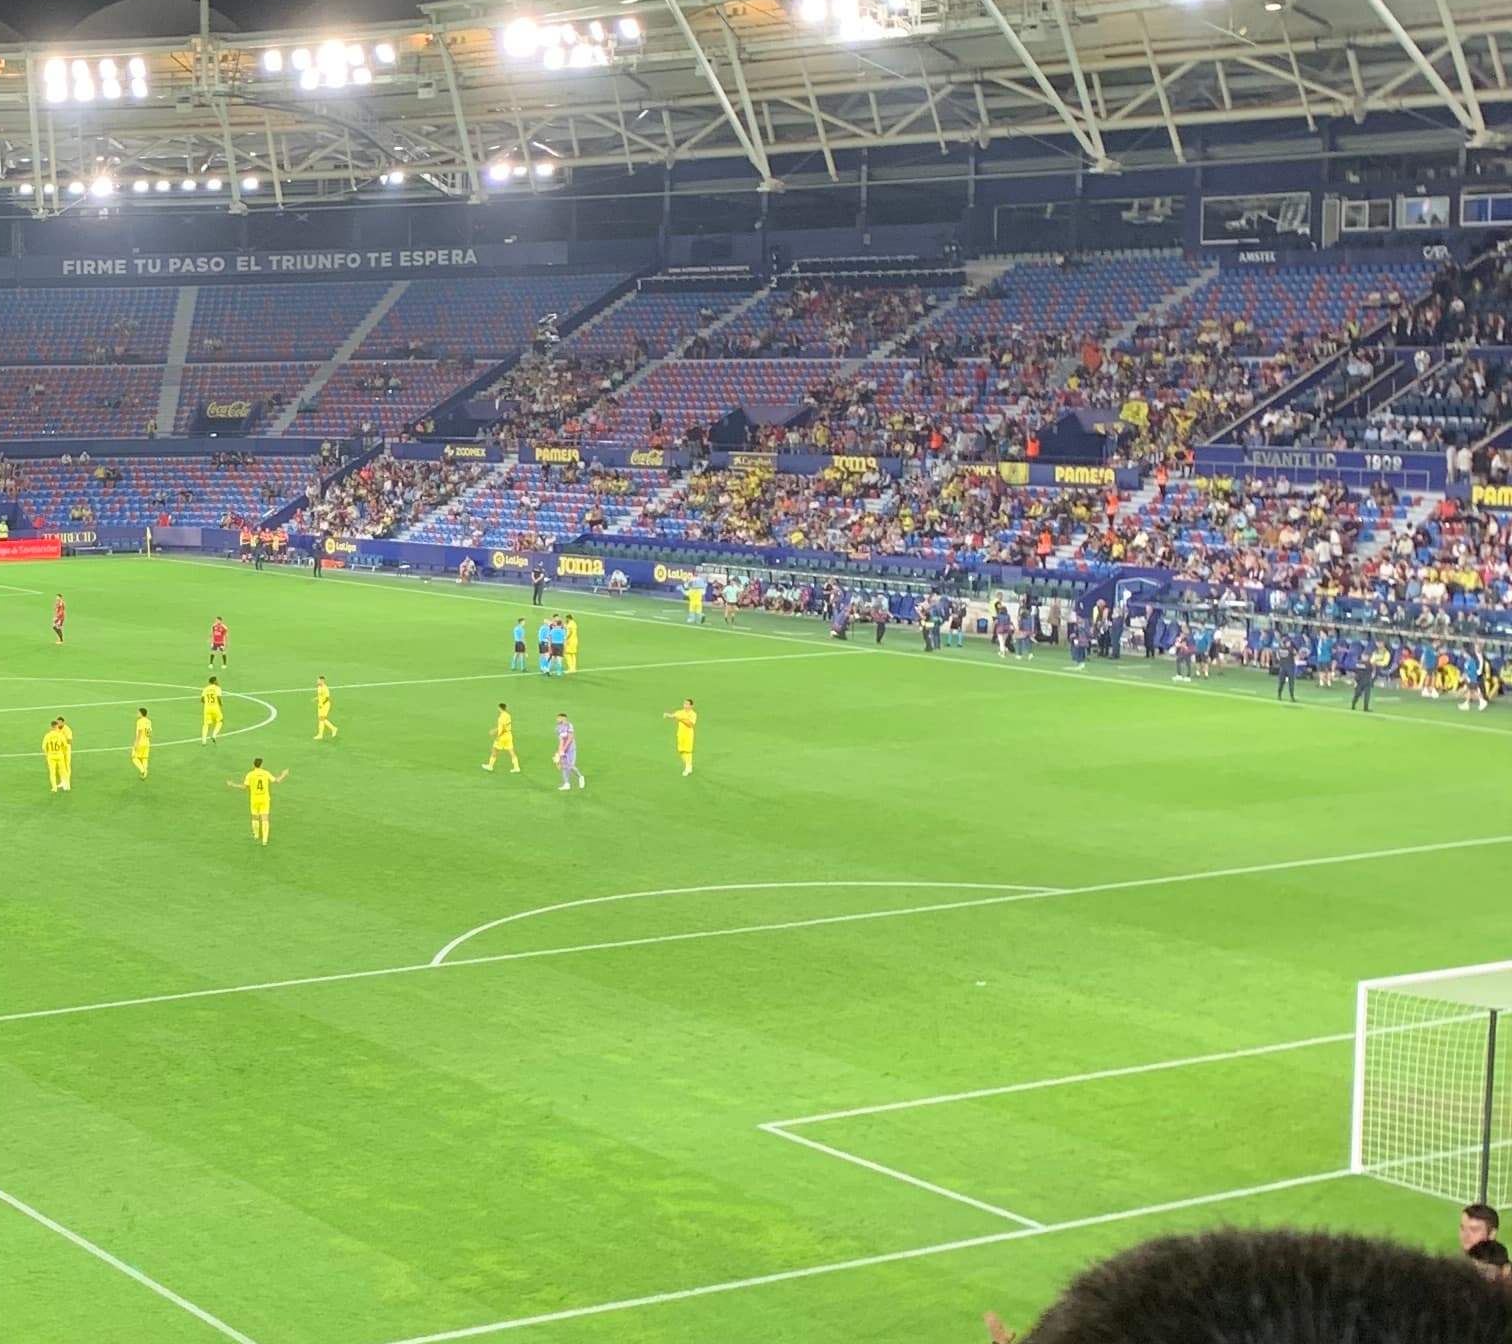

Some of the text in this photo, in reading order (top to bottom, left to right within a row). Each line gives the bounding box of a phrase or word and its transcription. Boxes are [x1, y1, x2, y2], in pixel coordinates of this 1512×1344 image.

[63, 248, 477, 275] FIRME TU PASO EL TRIUNFO TE ESPERA
[557, 556, 604, 575] Joma
